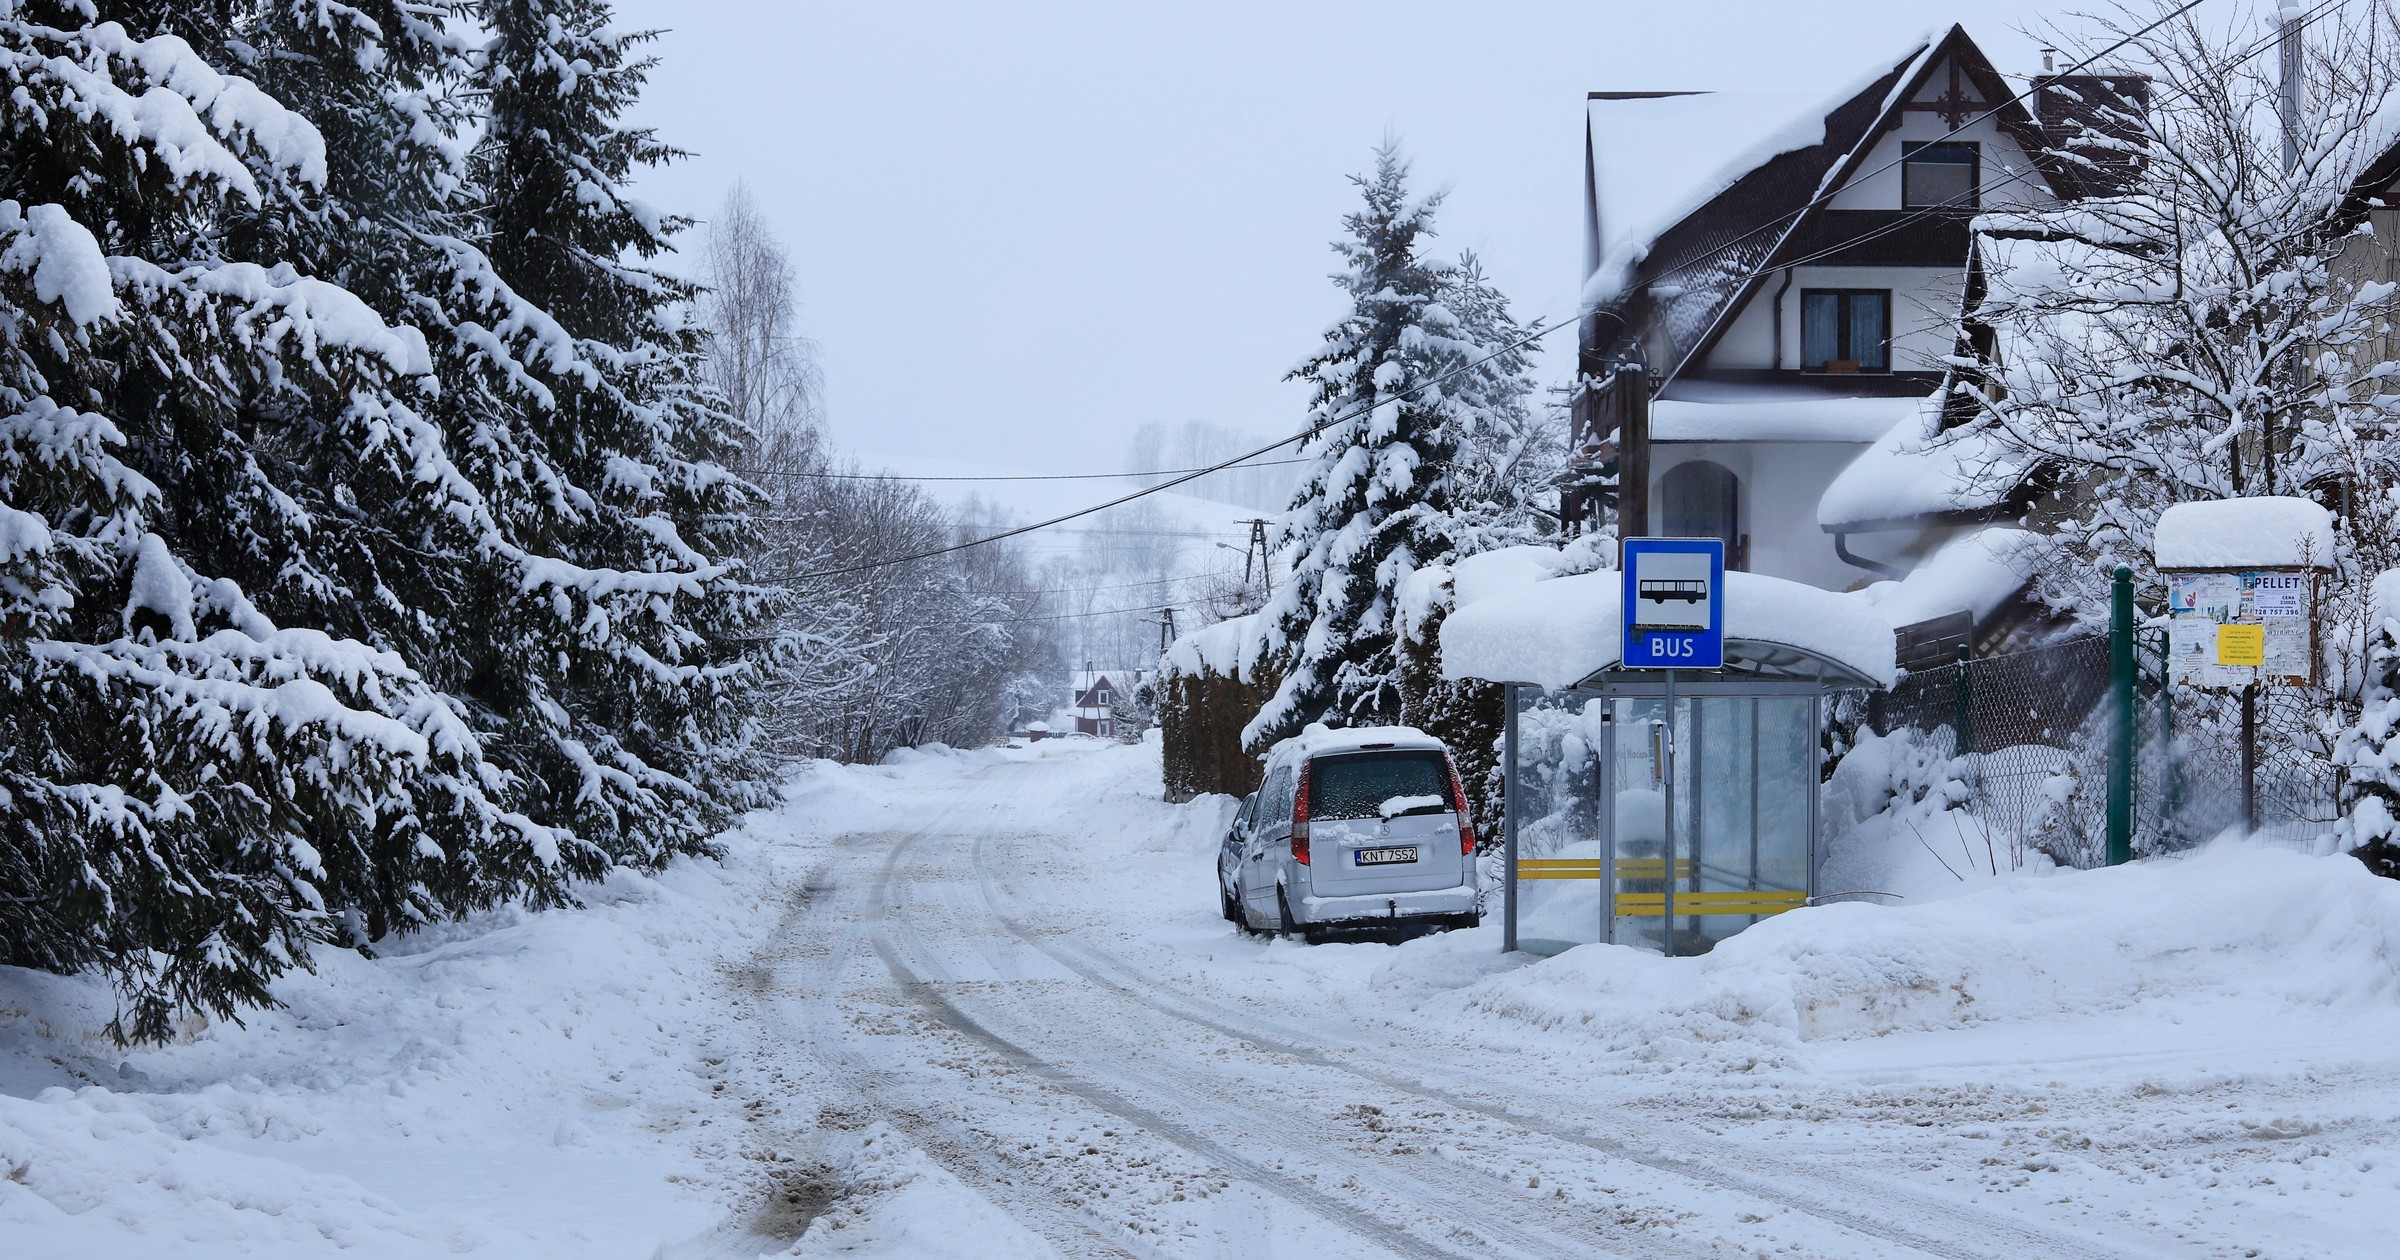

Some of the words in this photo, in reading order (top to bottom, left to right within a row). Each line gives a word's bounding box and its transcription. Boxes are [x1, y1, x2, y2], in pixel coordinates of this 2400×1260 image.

[2254, 577, 2300, 589] PELLET
[1651, 638, 1694, 658] BUS
[1362, 851, 1385, 862] KNT
